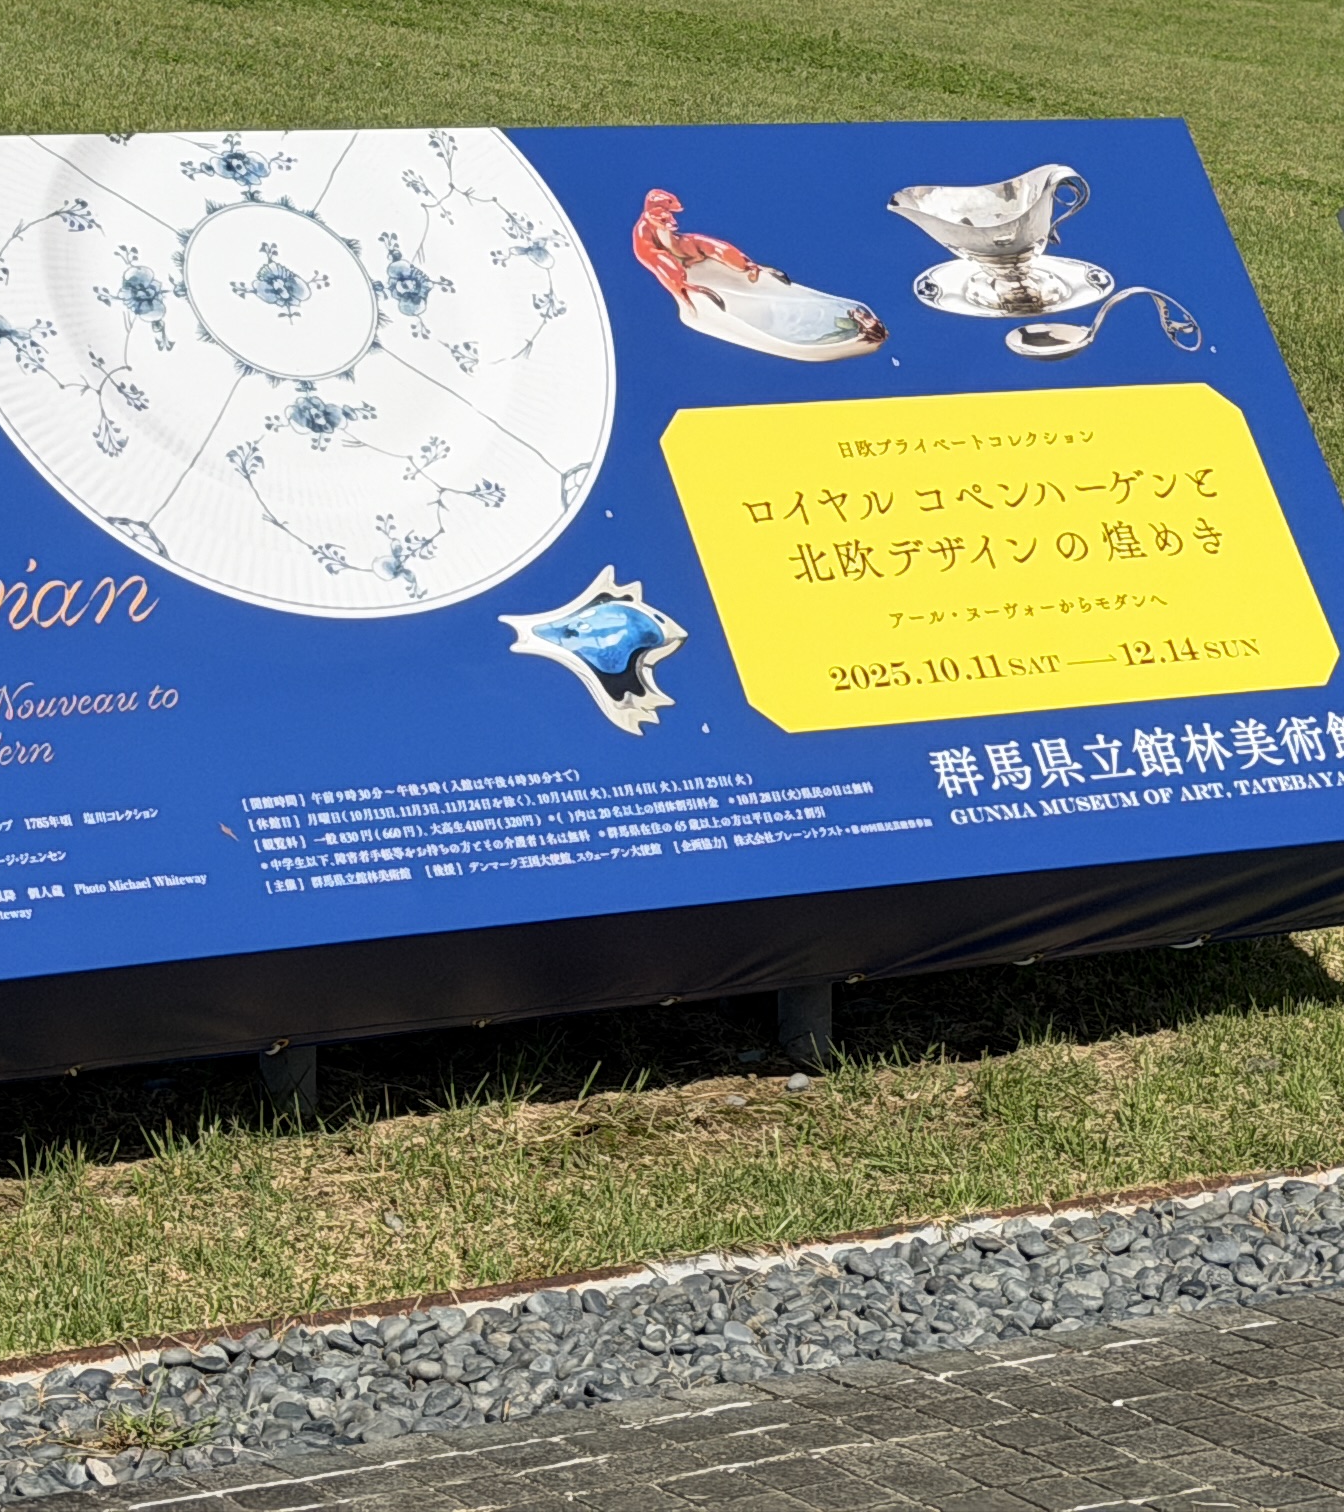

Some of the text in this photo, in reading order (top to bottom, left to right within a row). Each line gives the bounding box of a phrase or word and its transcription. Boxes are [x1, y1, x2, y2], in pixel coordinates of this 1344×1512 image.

[837, 430, 1095, 458] 日欧プライベートコレクション
[743, 469, 1217, 524] ロイヤル コペンハーゲンと
[789, 518, 1222, 582] 北欧デザインの煌めき
[888, 592, 1168, 628] アール・ヌーヴォーからモダンへ
[829, 638, 1261, 692] 2025.10.11 SAT 12.14 SUN
[147, 685, 180, 712] to
[951, 803, 1037, 825] GUNMA
[1041, 790, 1148, 816] MUSEUM
[1150, 788, 1173, 804] OF
[1181, 783, 1231, 801] ART,
[74, 884, 106, 895] Photo
[108, 877, 154, 891] Michael
[153, 875, 206, 886] Whiteway
